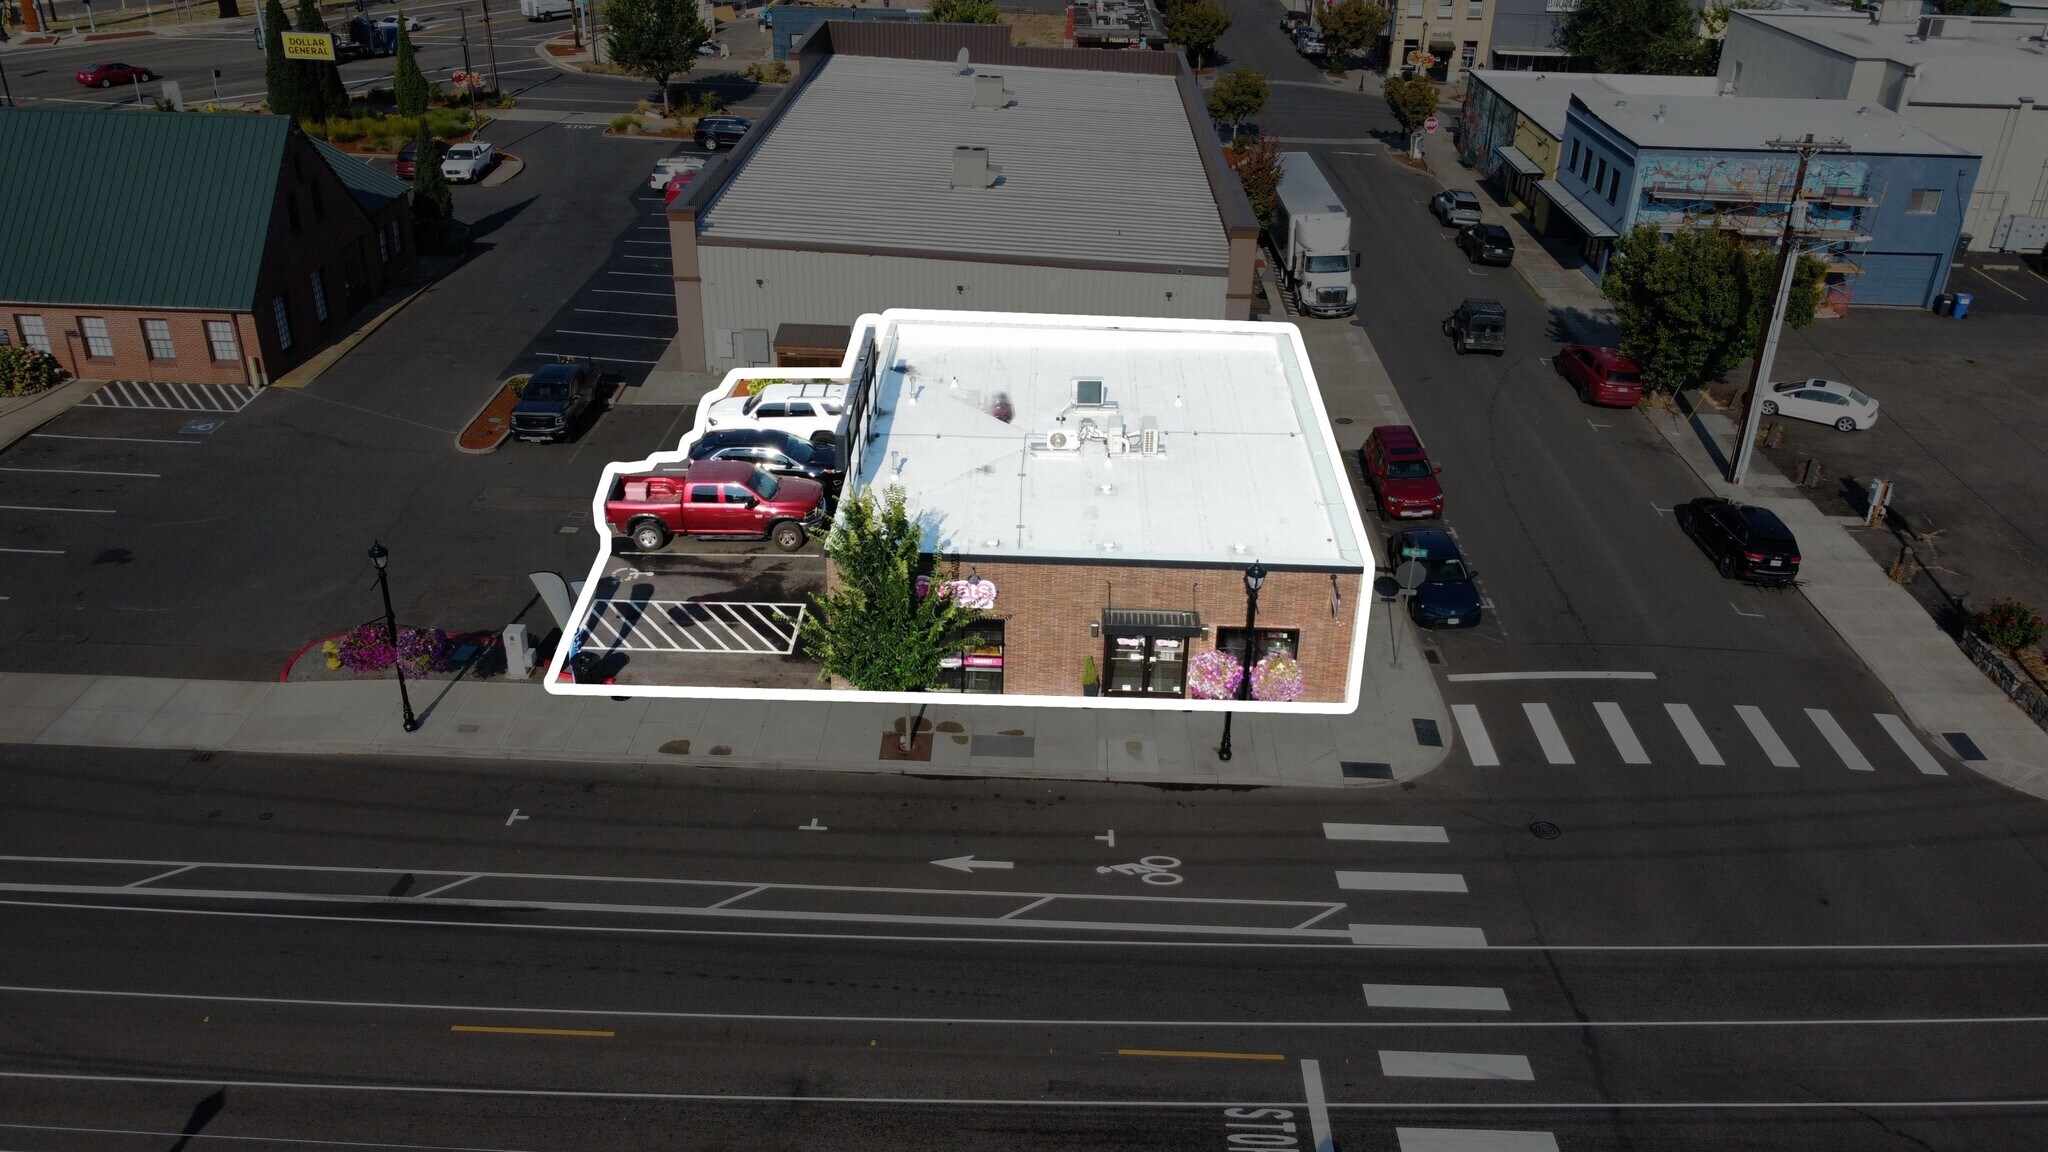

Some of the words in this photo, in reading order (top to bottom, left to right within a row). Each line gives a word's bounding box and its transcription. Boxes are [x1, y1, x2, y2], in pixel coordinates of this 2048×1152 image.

[288, 37, 325, 47] DOLLAR
[288, 47, 330, 56] GENERAL
[1224, 1107, 1299, 1152] STO
